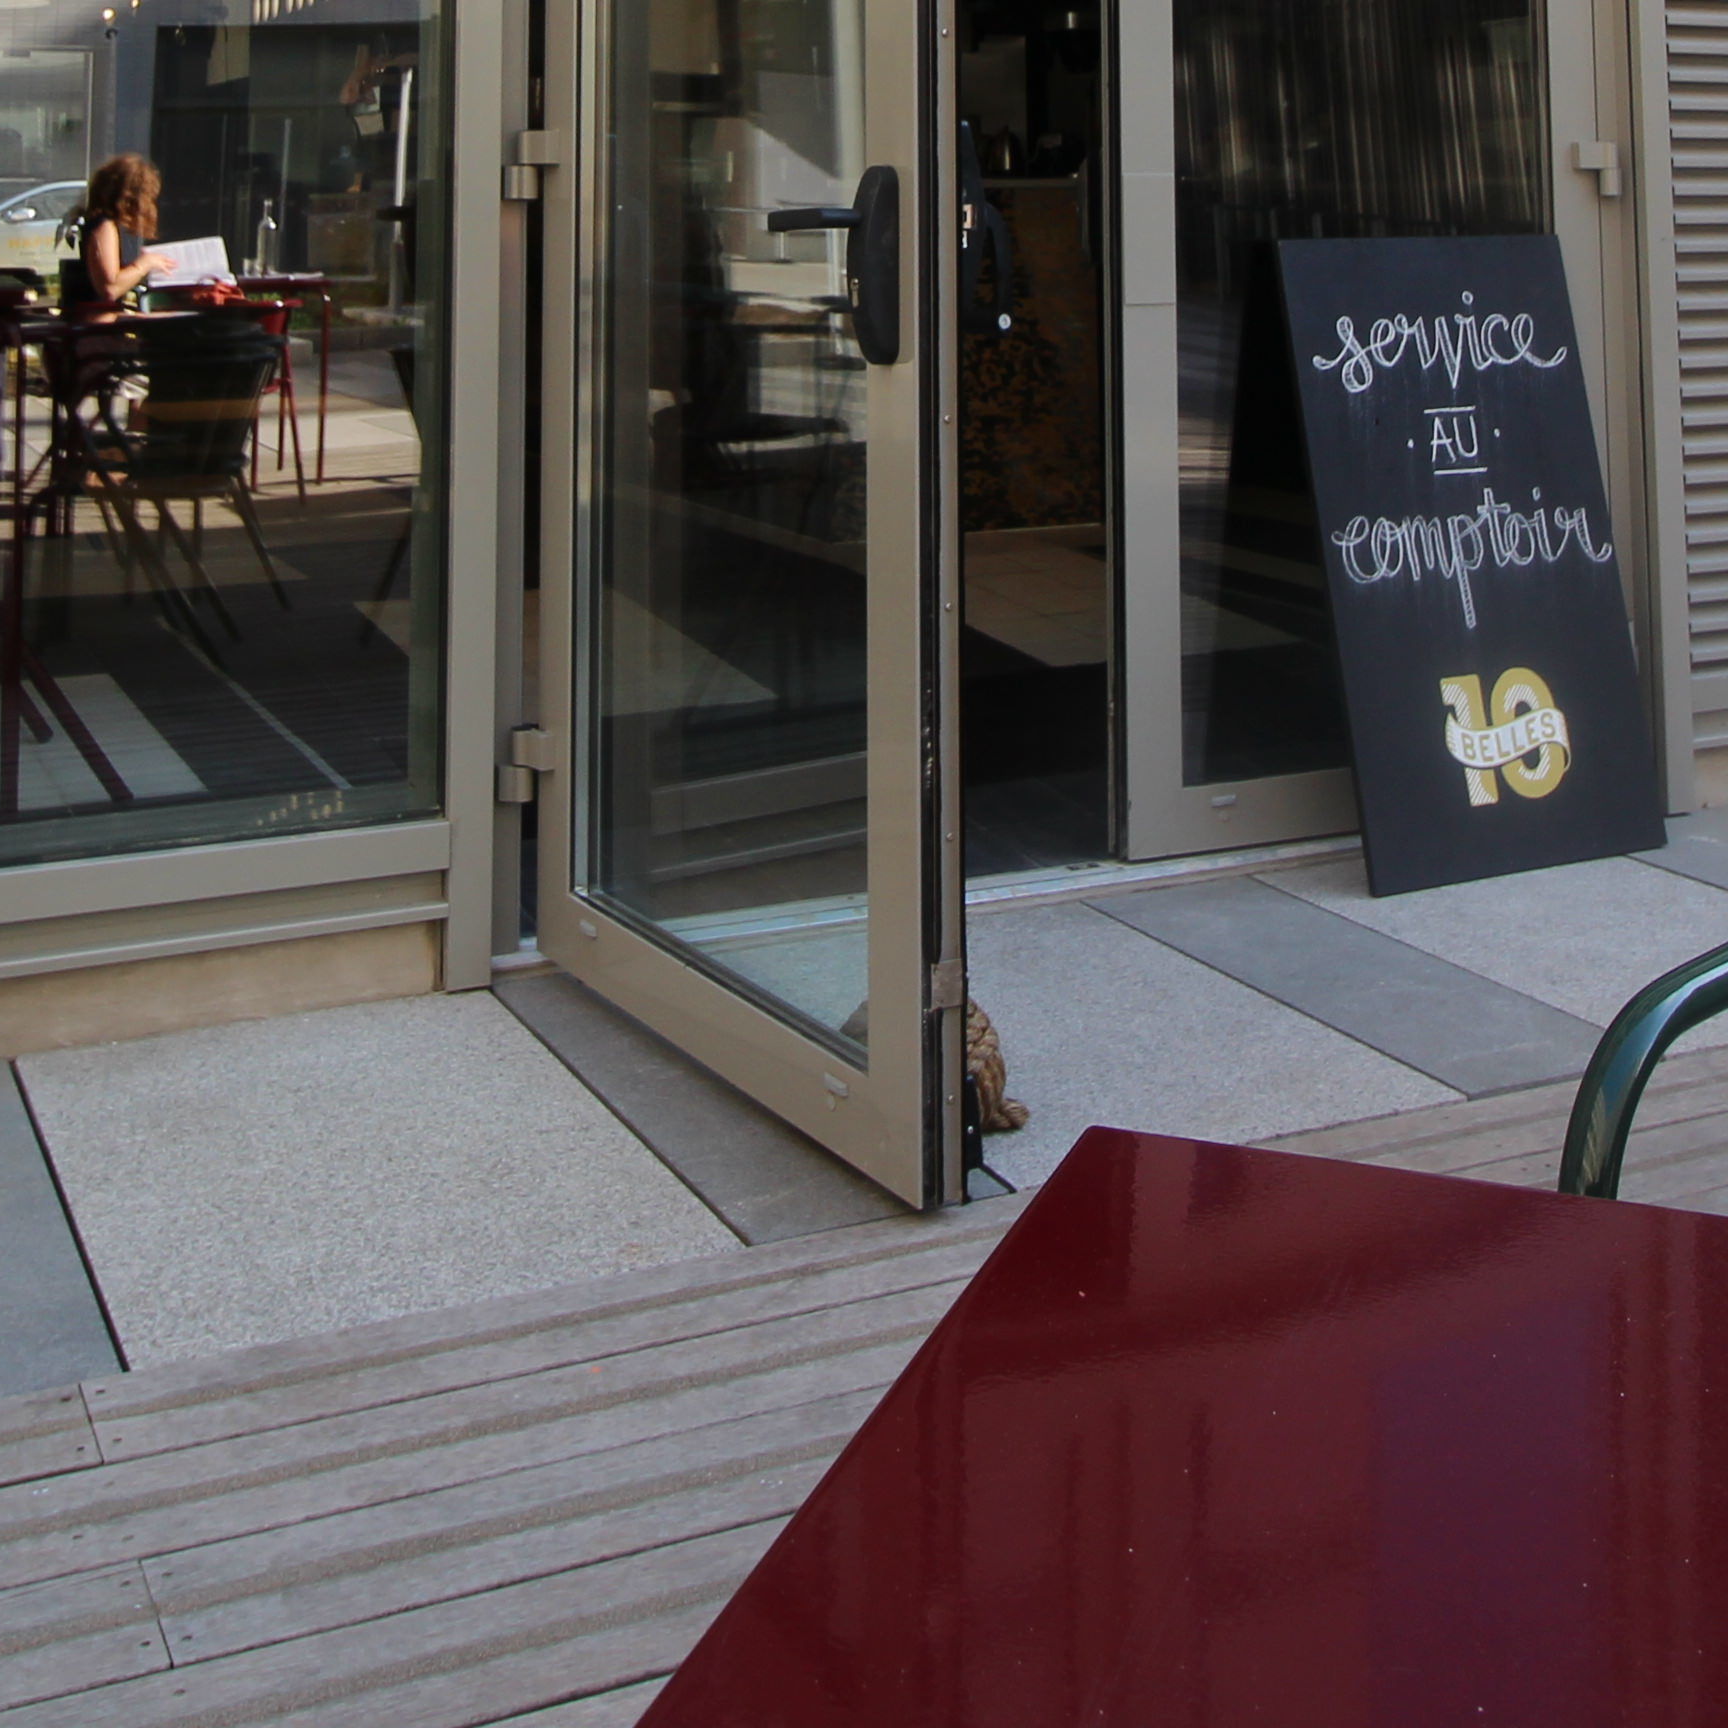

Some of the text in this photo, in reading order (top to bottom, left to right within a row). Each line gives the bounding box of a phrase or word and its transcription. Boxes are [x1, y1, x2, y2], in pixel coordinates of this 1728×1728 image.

[1313, 291, 1568, 394] service
[1430, 416, 1480, 463] AU
[1332, 487, 1612, 629] comptoir
[1440, 667, 1565, 807] 10 BELLES
